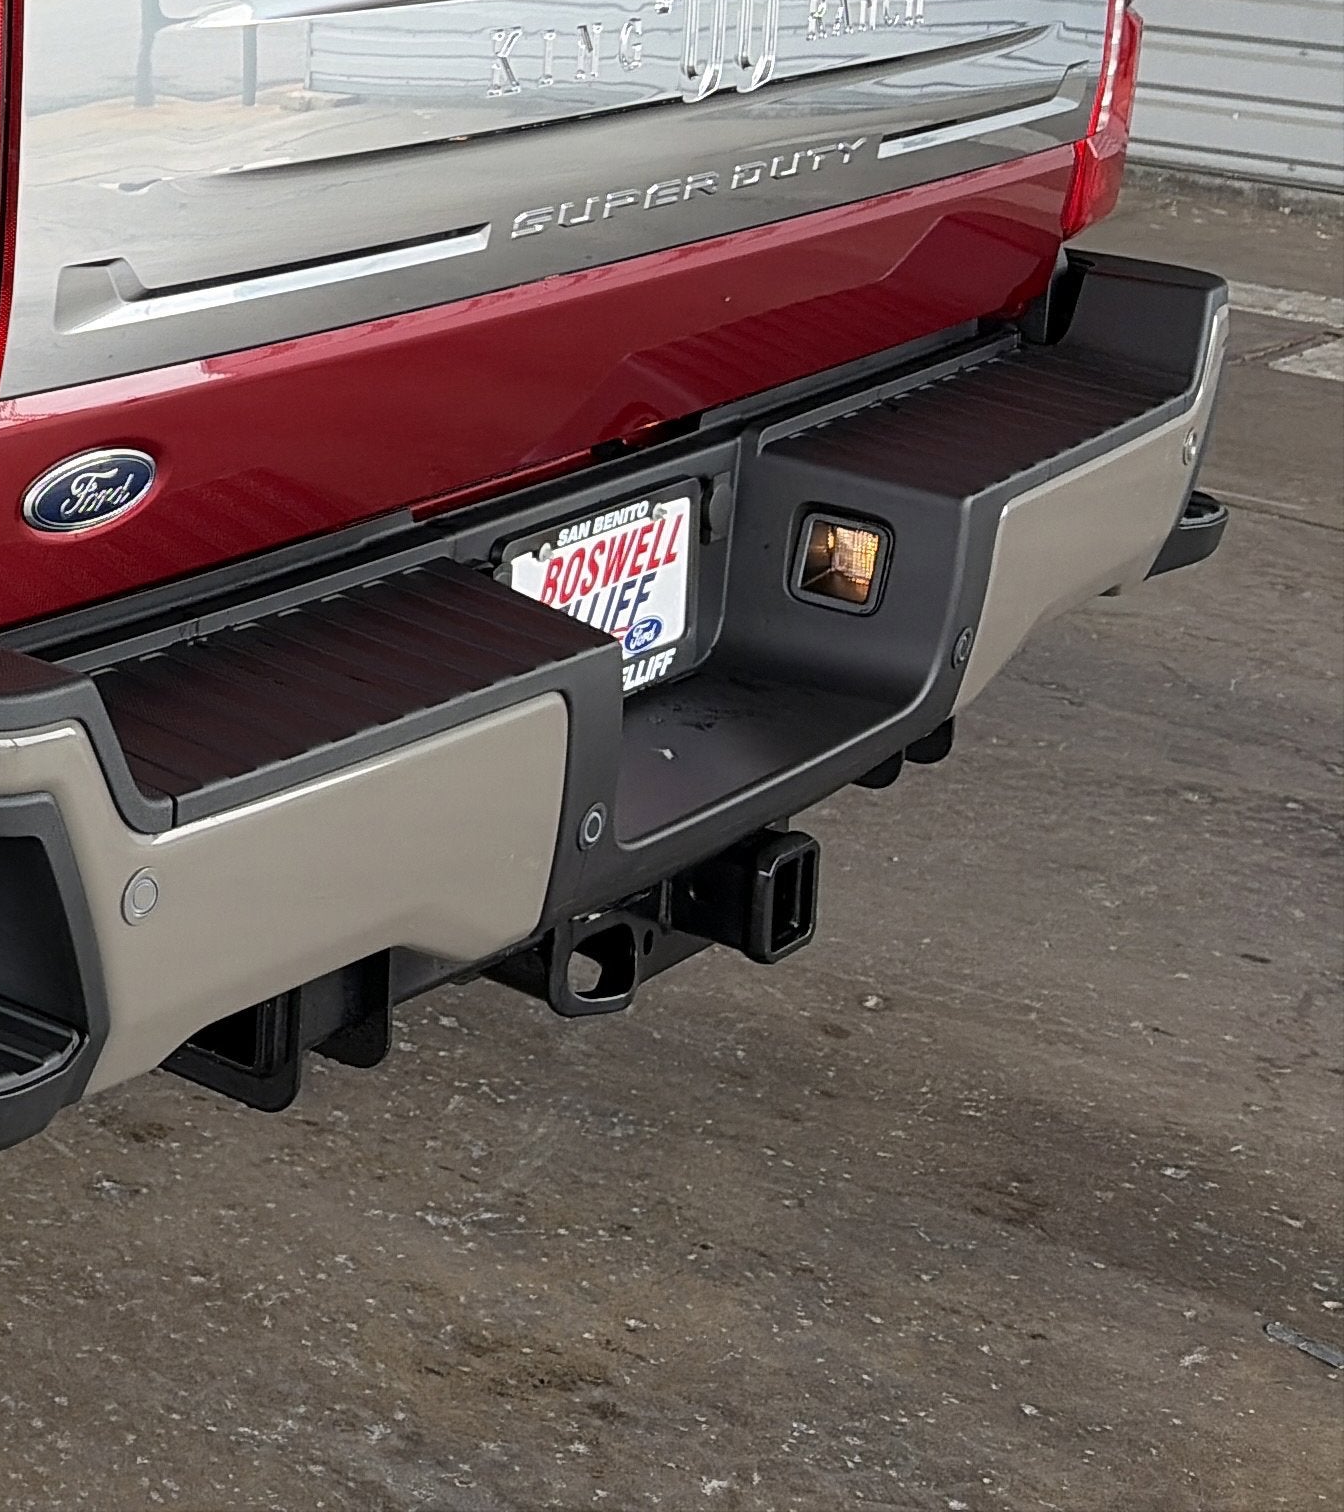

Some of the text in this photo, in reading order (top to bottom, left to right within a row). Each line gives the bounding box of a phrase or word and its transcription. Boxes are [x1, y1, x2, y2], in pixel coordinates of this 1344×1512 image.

[486, 17, 643, 98] KING
[511, 136, 867, 239] SUPER DUTY
[60, 467, 135, 516] Ford
[557, 500, 649, 546] SAN BENITO
[539, 513, 684, 607] BOSWELL
[629, 620, 658, 649] Ford
